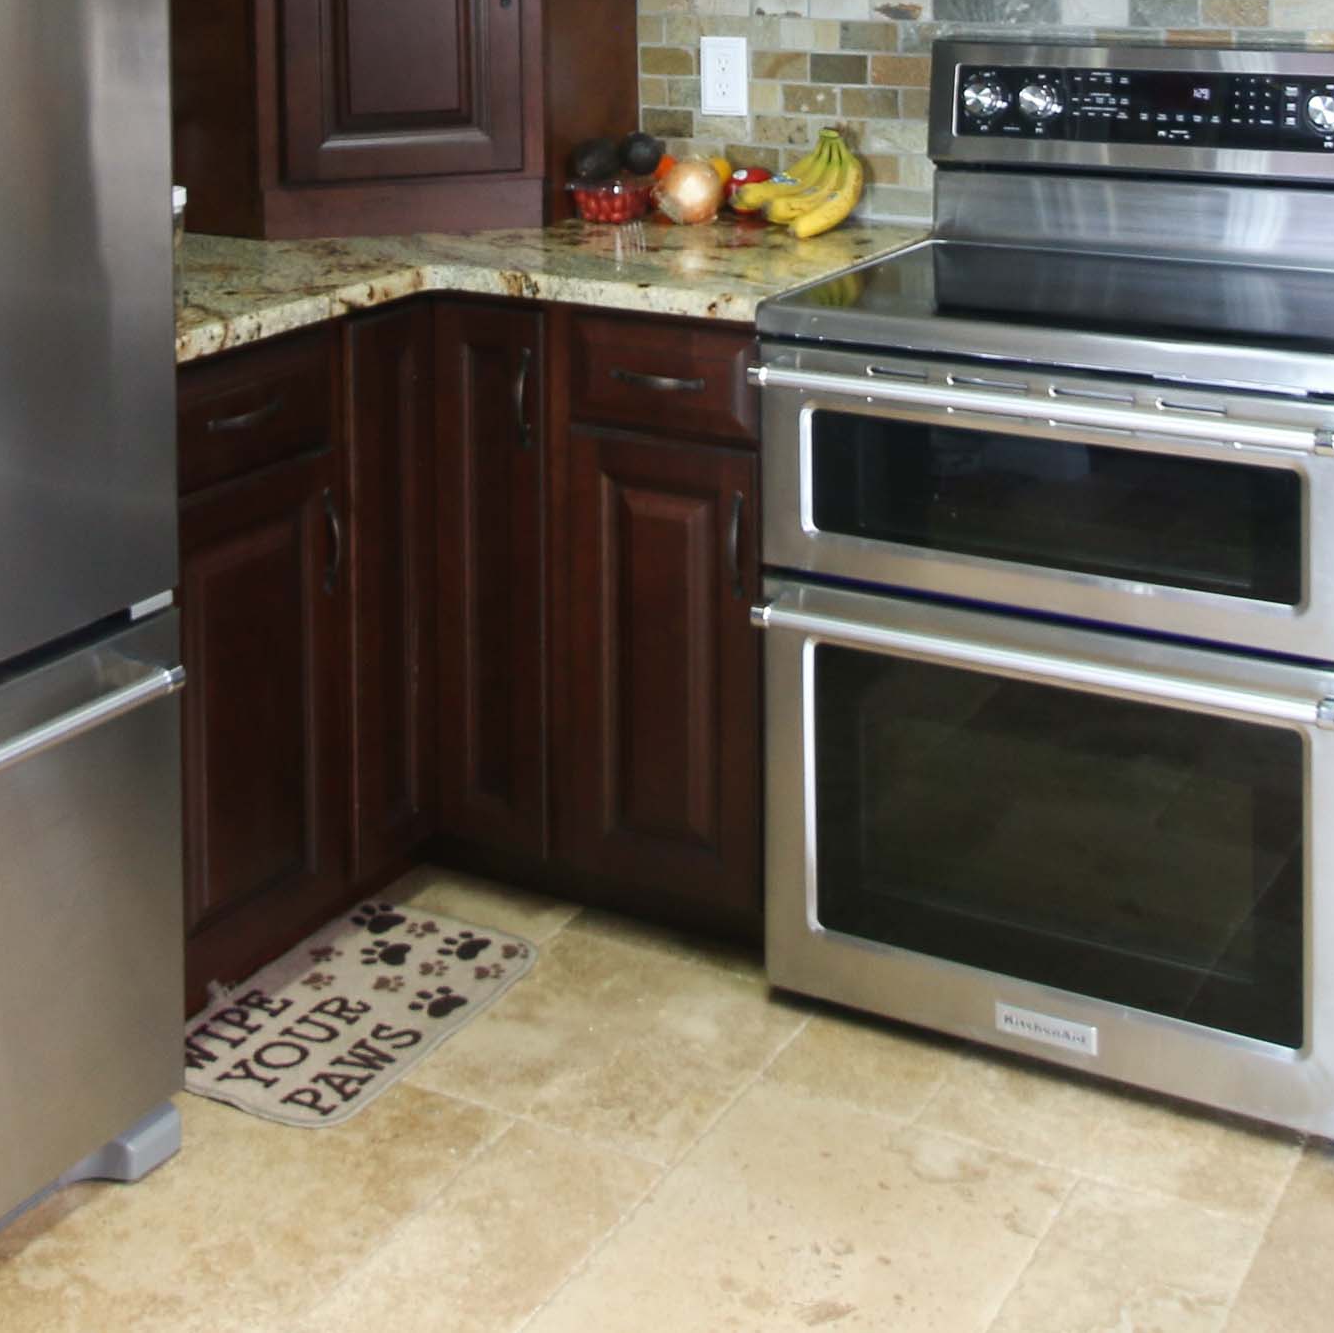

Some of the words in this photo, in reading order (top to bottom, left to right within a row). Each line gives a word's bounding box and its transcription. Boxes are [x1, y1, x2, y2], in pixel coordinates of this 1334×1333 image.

[216, 995, 371, 1089] YOUR
[281, 1023, 423, 1116] PAWS
[1003, 1013, 1086, 1044] KitchenAid
